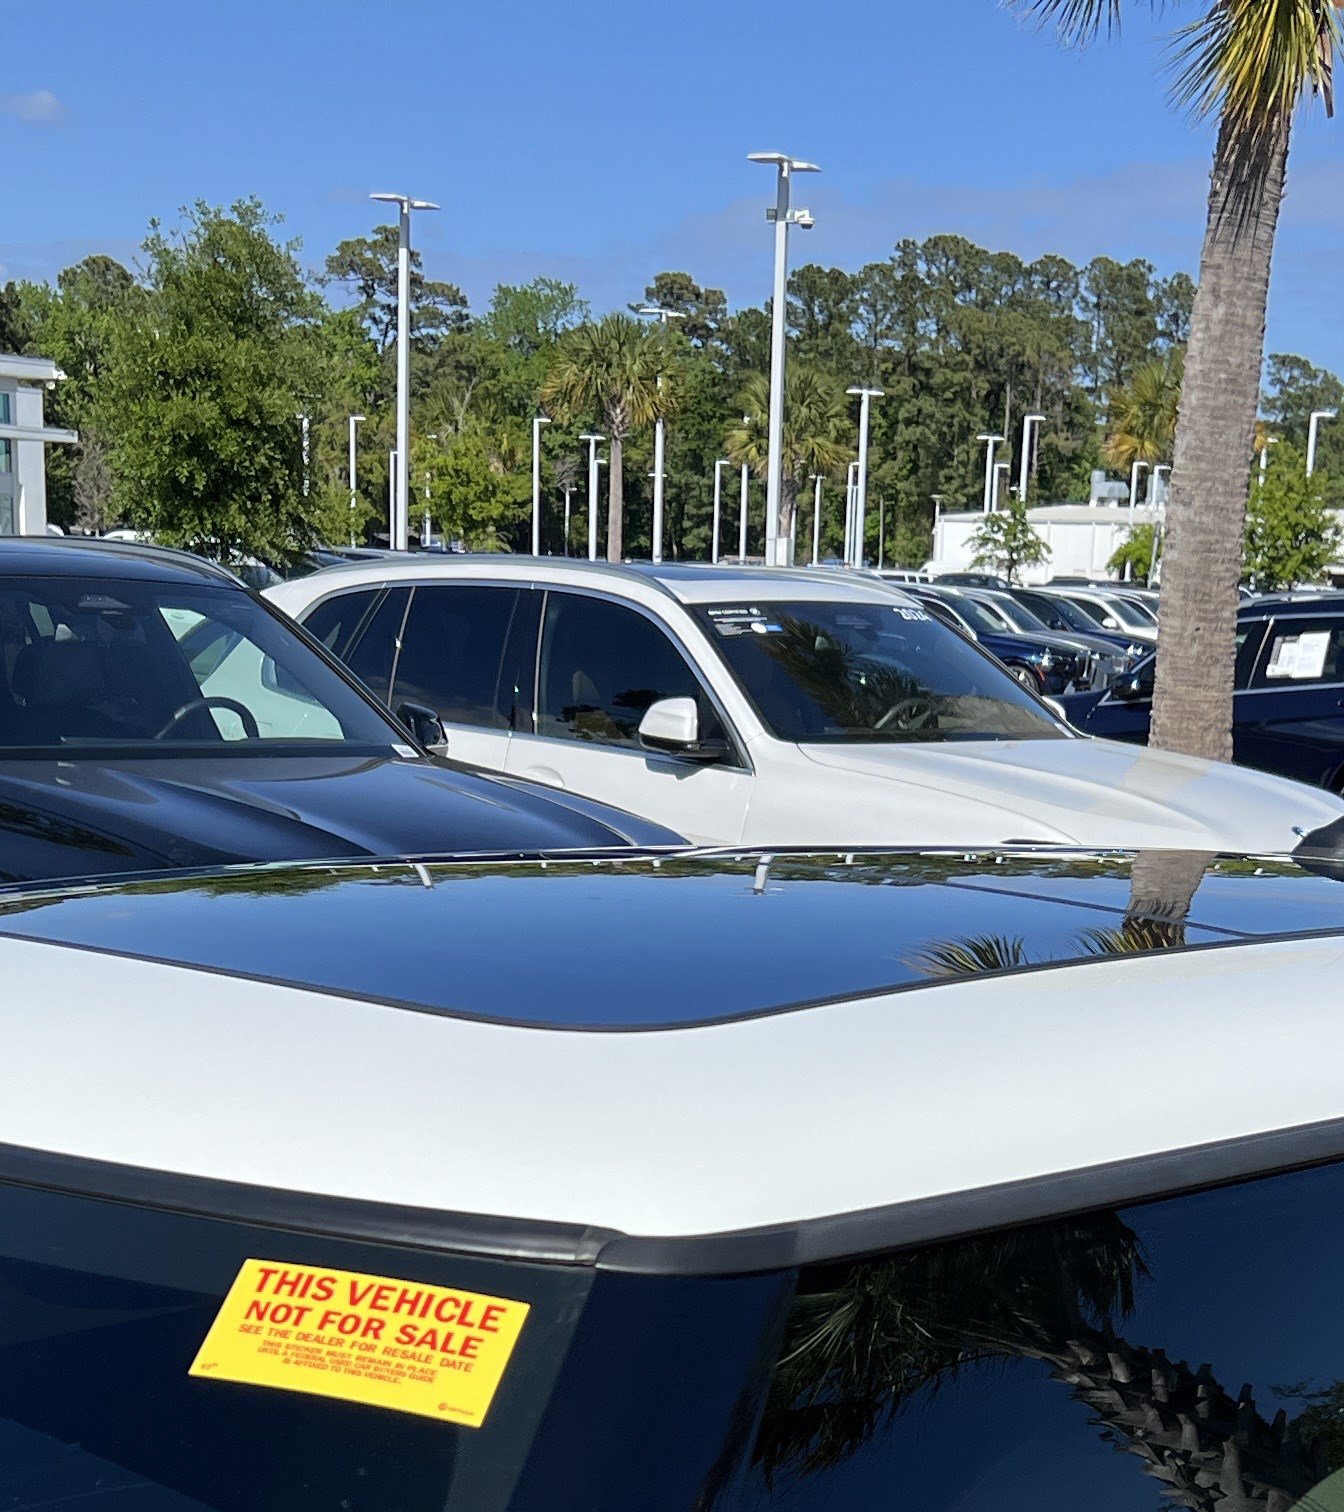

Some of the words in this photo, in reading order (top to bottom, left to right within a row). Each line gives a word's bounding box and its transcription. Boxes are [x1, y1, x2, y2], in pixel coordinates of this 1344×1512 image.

[253, 1268, 337, 1302] THIS
[348, 1280, 507, 1333] VEHICLE
[238, 1323, 263, 1336] SEE
[267, 1328, 293, 1339] THE
[295, 1331, 346, 1347] DEALER
[349, 1340, 378, 1354] FOR
[382, 1346, 435, 1364] RESALE
[439, 1357, 475, 1373] DATE
[244, 1299, 312, 1327] NOT
[317, 1310, 385, 1341] FOR
[394, 1324, 485, 1359] SALE
[407, 1364, 439, 1376] PLACE
